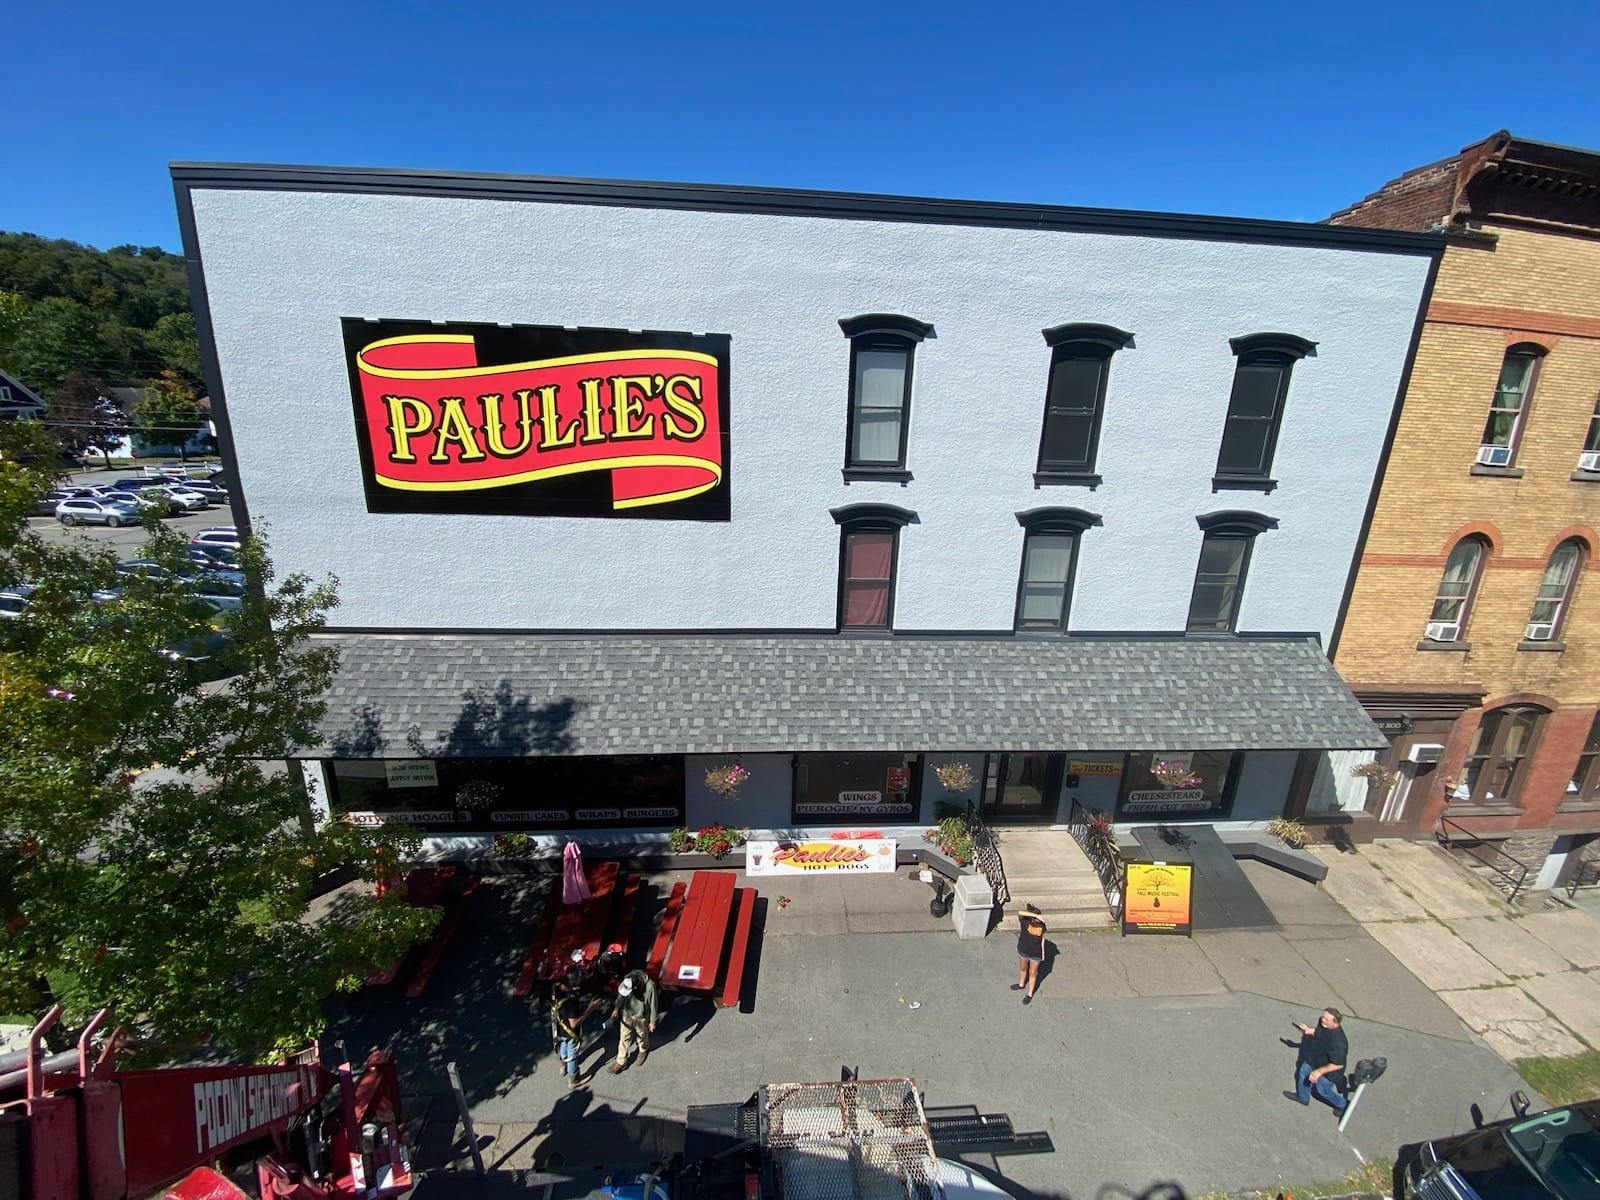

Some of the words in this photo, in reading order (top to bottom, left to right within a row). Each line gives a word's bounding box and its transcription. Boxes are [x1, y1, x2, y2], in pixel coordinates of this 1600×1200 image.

[384, 376, 706, 463] PAULIE'S
[1084, 764, 1114, 773] TICKETS
[842, 793, 877, 802] WINGS
[1131, 791, 1201, 801] CHEESESTEAKS
[876, 805, 910, 813] GYROS
[1127, 803, 1158, 811] FRESH
[1160, 803, 1178, 811] CUT
[495, 813, 532, 821] FUNNEL
[534, 812, 566, 820] CAKES
[577, 811, 617, 819] WRAPS
[626, 809, 675, 818] BURGERS
[773, 843, 869, 866] Paulie's
[194, 1077, 248, 1154] POCONO
[248, 1073, 270, 1130] SIGN
